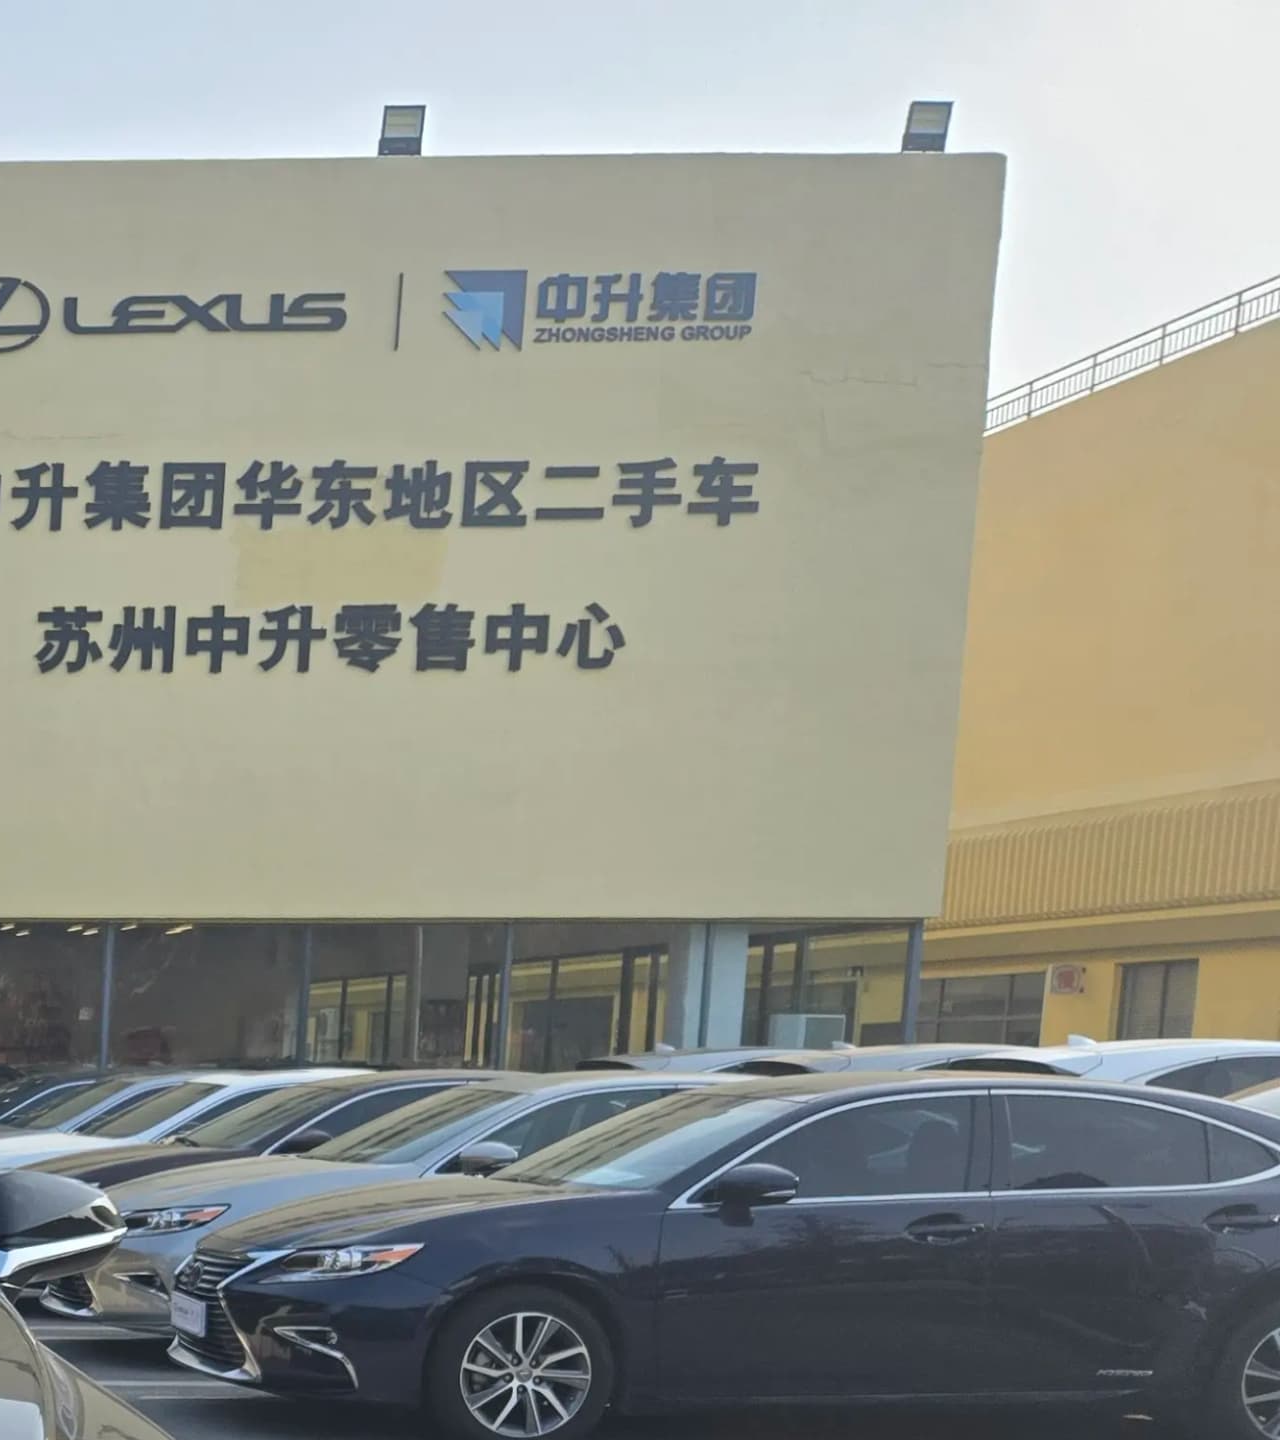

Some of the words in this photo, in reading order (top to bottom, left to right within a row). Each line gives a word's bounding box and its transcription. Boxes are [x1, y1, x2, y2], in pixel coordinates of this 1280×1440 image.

[63, 293, 347, 335] LEXUS
[535, 272, 757, 323] 中升集团
[533, 325, 676, 343] ZHONGSHENG
[681, 324, 753, 341] GROUP
[33, 601, 626, 675] 苏州中升零售中心
